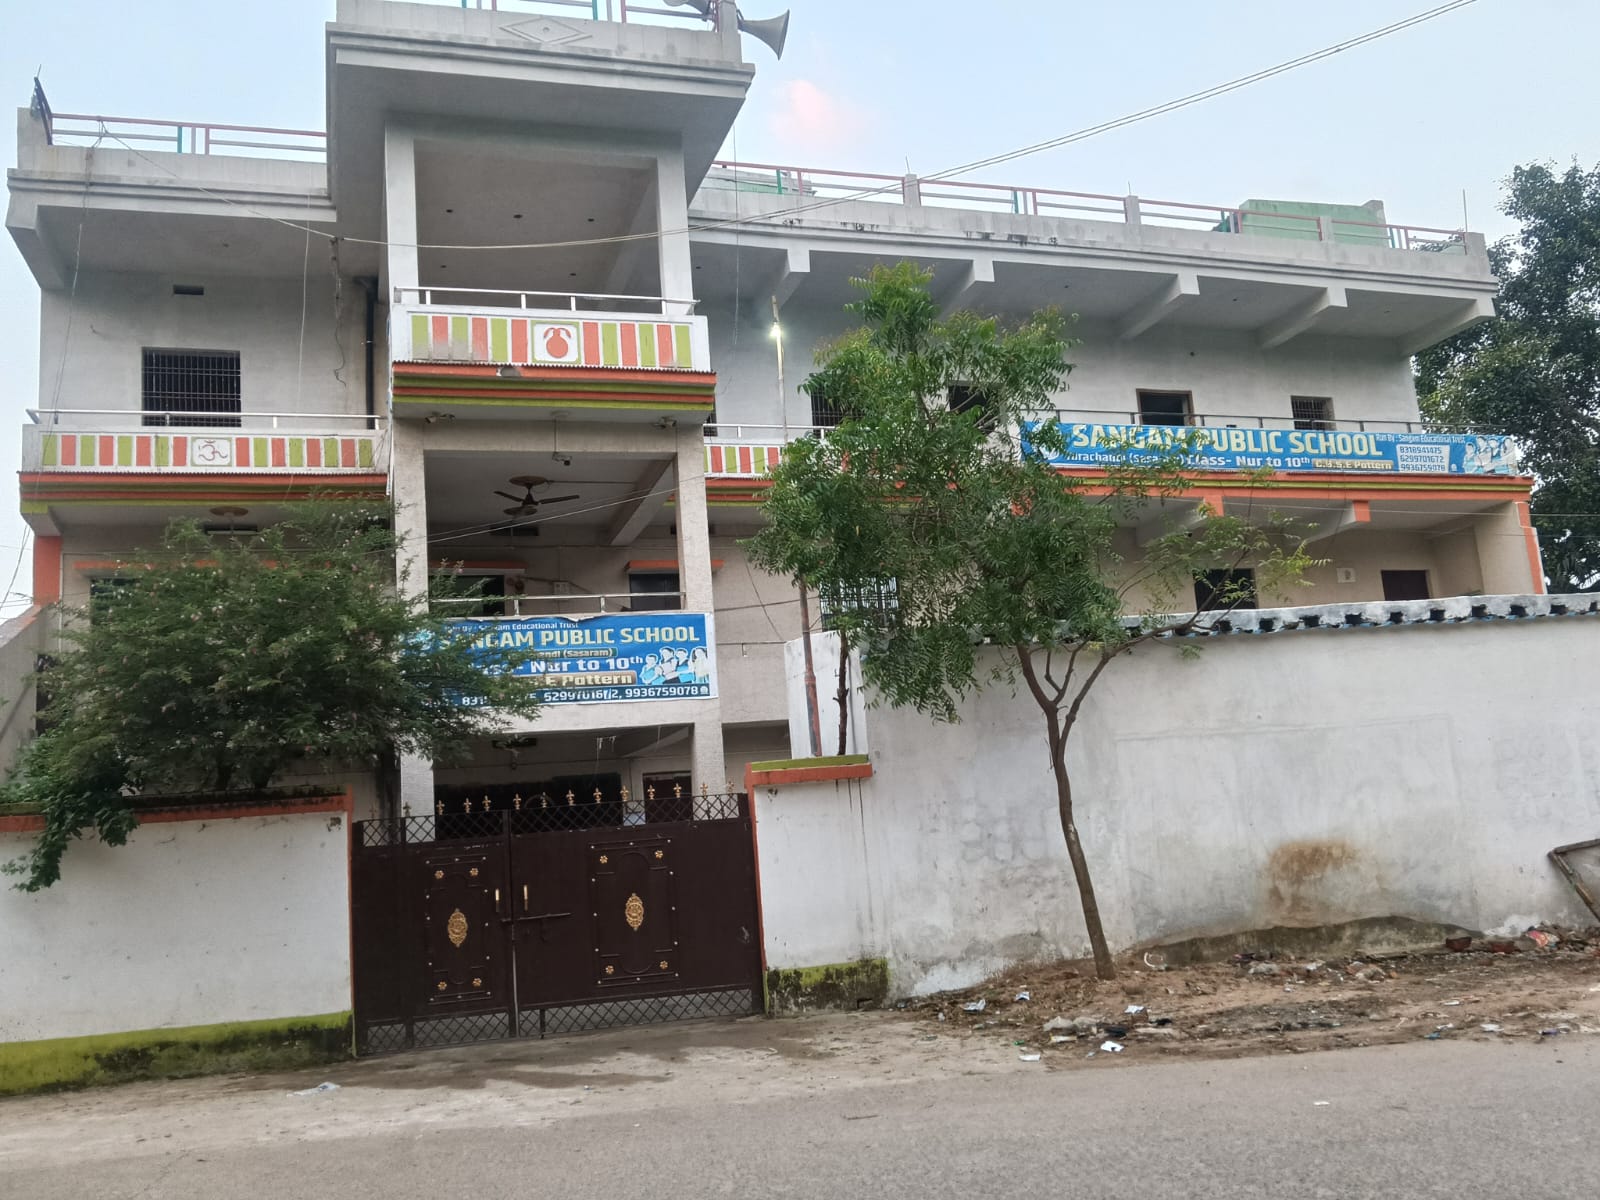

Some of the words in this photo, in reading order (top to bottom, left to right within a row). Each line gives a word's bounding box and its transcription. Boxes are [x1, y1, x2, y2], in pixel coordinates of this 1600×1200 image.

[1073, 424, 1187, 450] SANGAM
[1196, 428, 1284, 453] PUBLIC
[1289, 431, 1383, 456] SCHOOL
[1236, 455, 1262, 466] Nur
[1265, 457, 1281, 467] to
[1285, 456, 1310, 467] 10th
[1354, 461, 1392, 470] Pattern
[512, 622, 557, 630] Educational
[560, 621, 579, 629] Trust
[541, 628, 615, 647] PUBLIC
[620, 626, 700, 644] SCHOOL
[563, 648, 613, 658] (Sasaram)
[531, 660, 571, 673] Nur
[577, 659, 600, 672] to
[606, 655, 643, 670] 10th
[562, 674, 632, 687] Pattern
[625, 685, 698, 699] 9936759078
